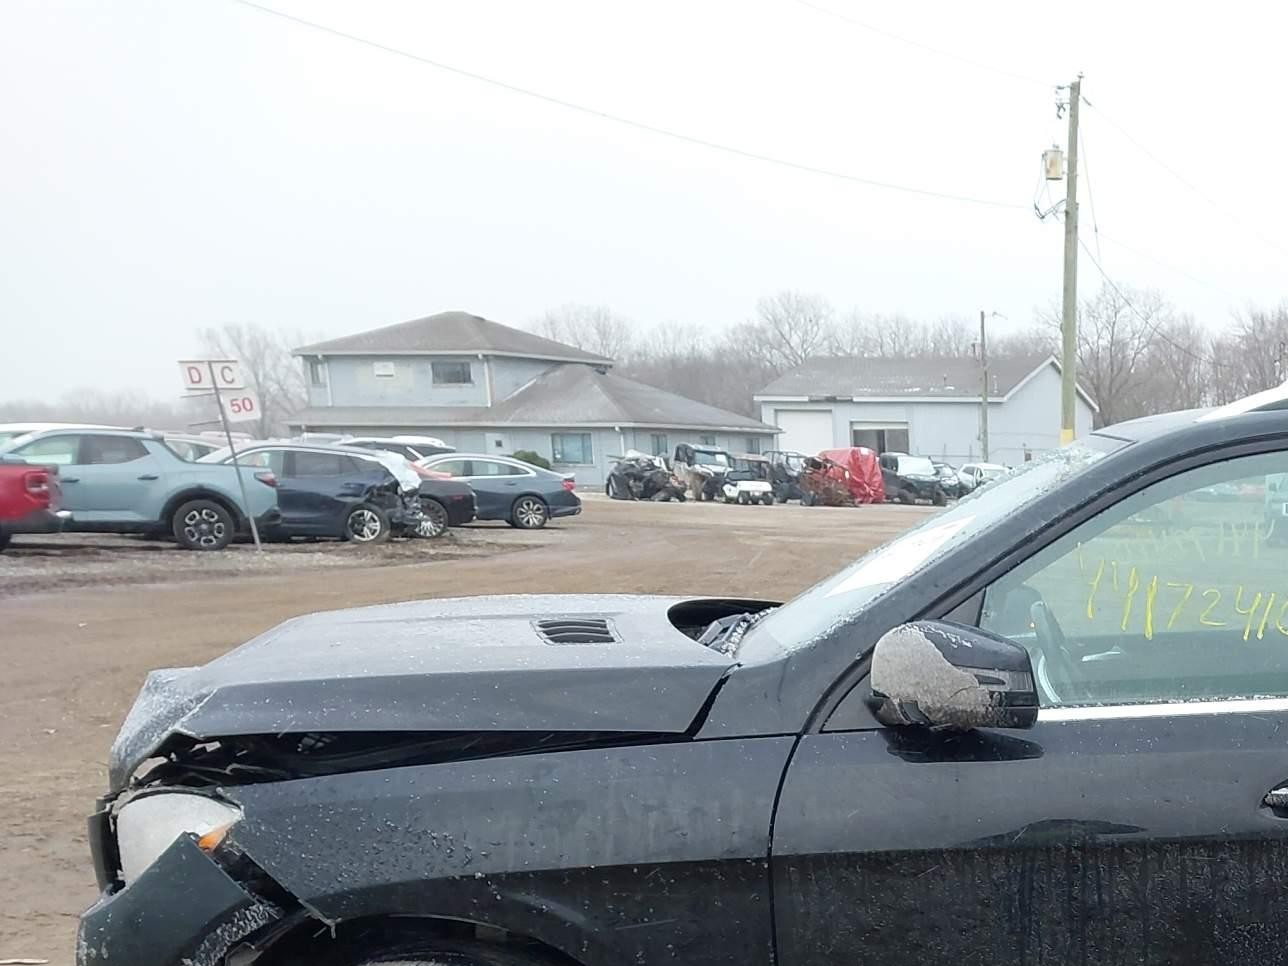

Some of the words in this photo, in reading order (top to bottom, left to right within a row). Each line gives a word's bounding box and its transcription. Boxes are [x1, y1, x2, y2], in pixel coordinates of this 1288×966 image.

[187, 365, 203, 385] D
[220, 365, 235, 385] C
[230, 396, 254, 414] 50
